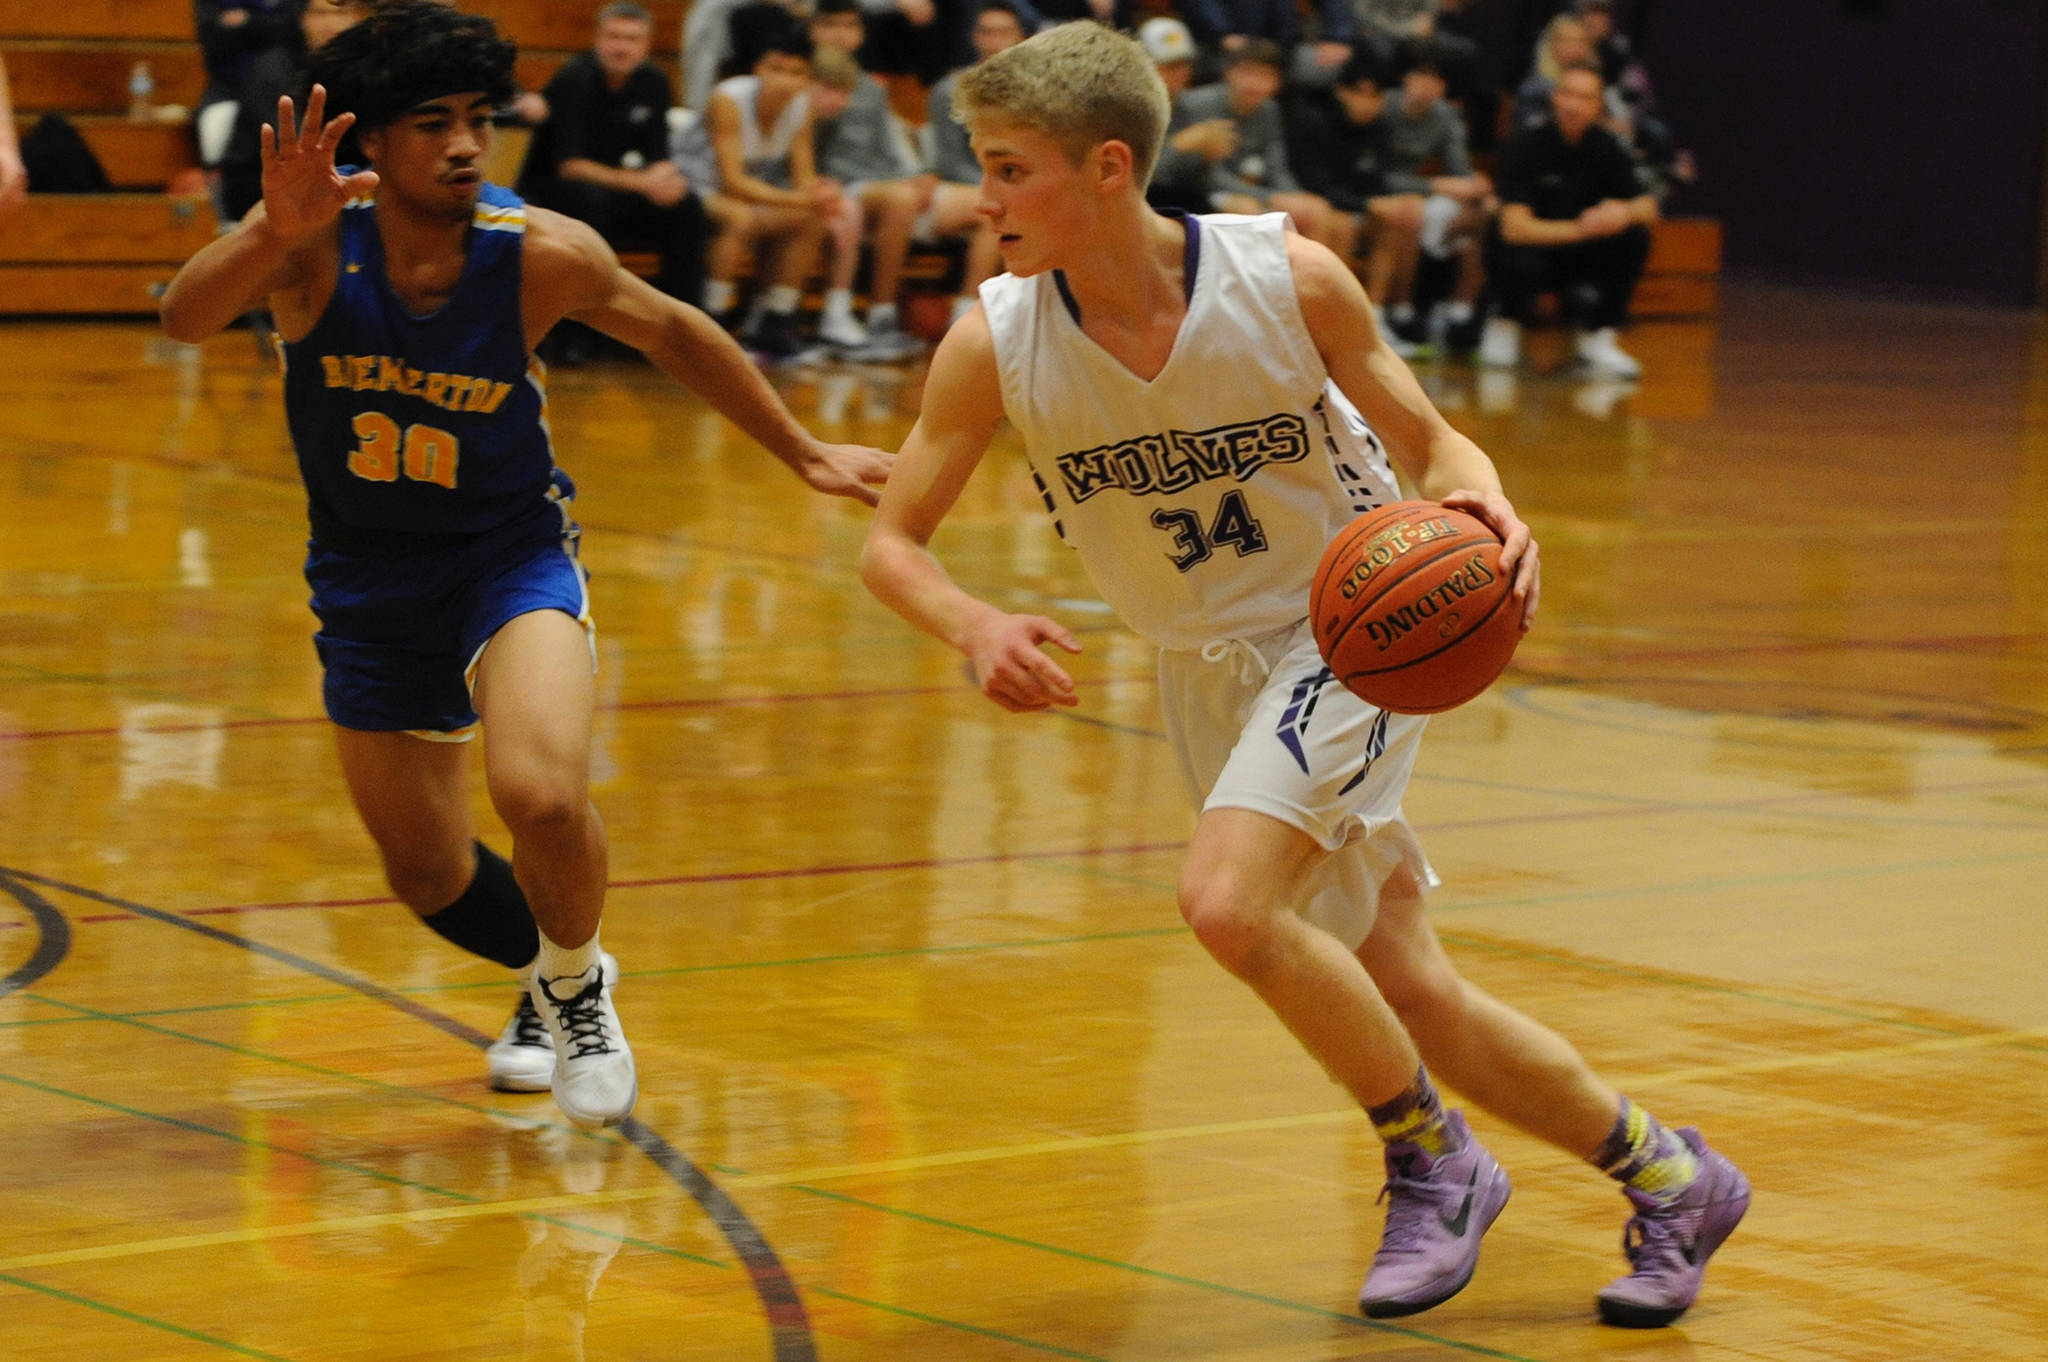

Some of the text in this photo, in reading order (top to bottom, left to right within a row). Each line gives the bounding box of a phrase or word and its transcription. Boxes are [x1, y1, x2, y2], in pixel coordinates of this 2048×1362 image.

[320, 355, 515, 413] BEMERTON
[347, 411, 459, 489] 30
[1056, 413, 1310, 504] WOLVES
[1151, 489, 1268, 572] 34
[1365, 553, 1495, 651] SPALDING
